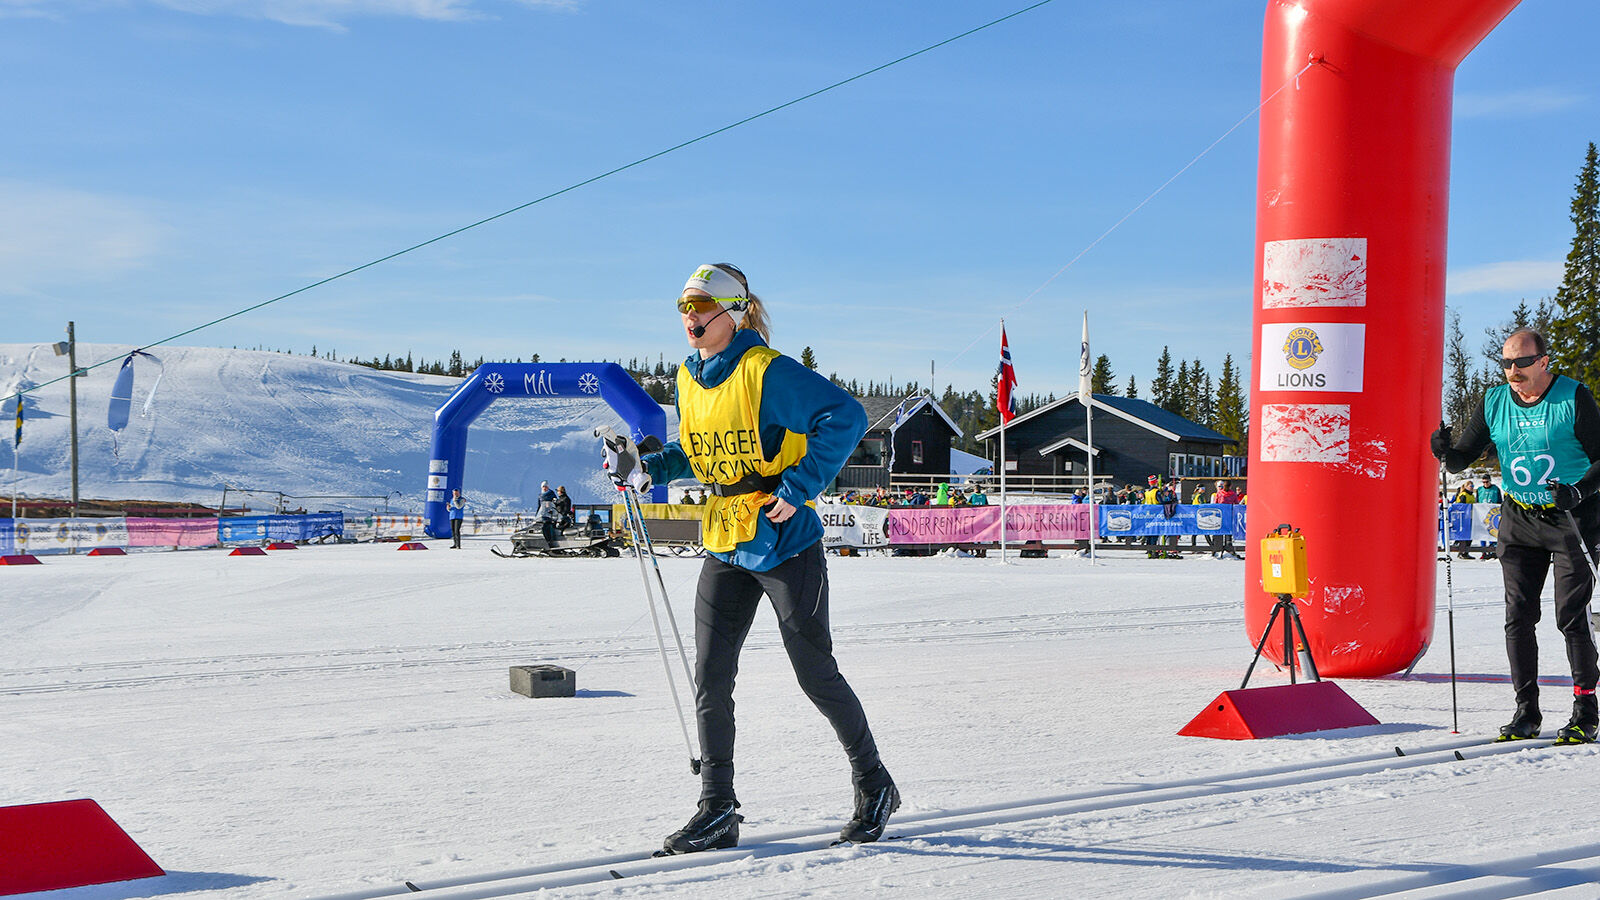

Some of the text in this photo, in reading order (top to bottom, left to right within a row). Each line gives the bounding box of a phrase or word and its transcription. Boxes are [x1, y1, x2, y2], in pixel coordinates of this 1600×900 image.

[1290, 329, 1316, 338] LIONS
[1297, 341, 1308, 356] L
[524, 370, 560, 394] MÅL
[1278, 373, 1326, 387] LIONS
[1510, 454, 1560, 486] 62
[822, 514, 856, 527] SELLS
[892, 515, 976, 535] RIDDERRENNET
[1005, 511, 1091, 533] RIDDERRENNET
[863, 533, 881, 545] LIFE
